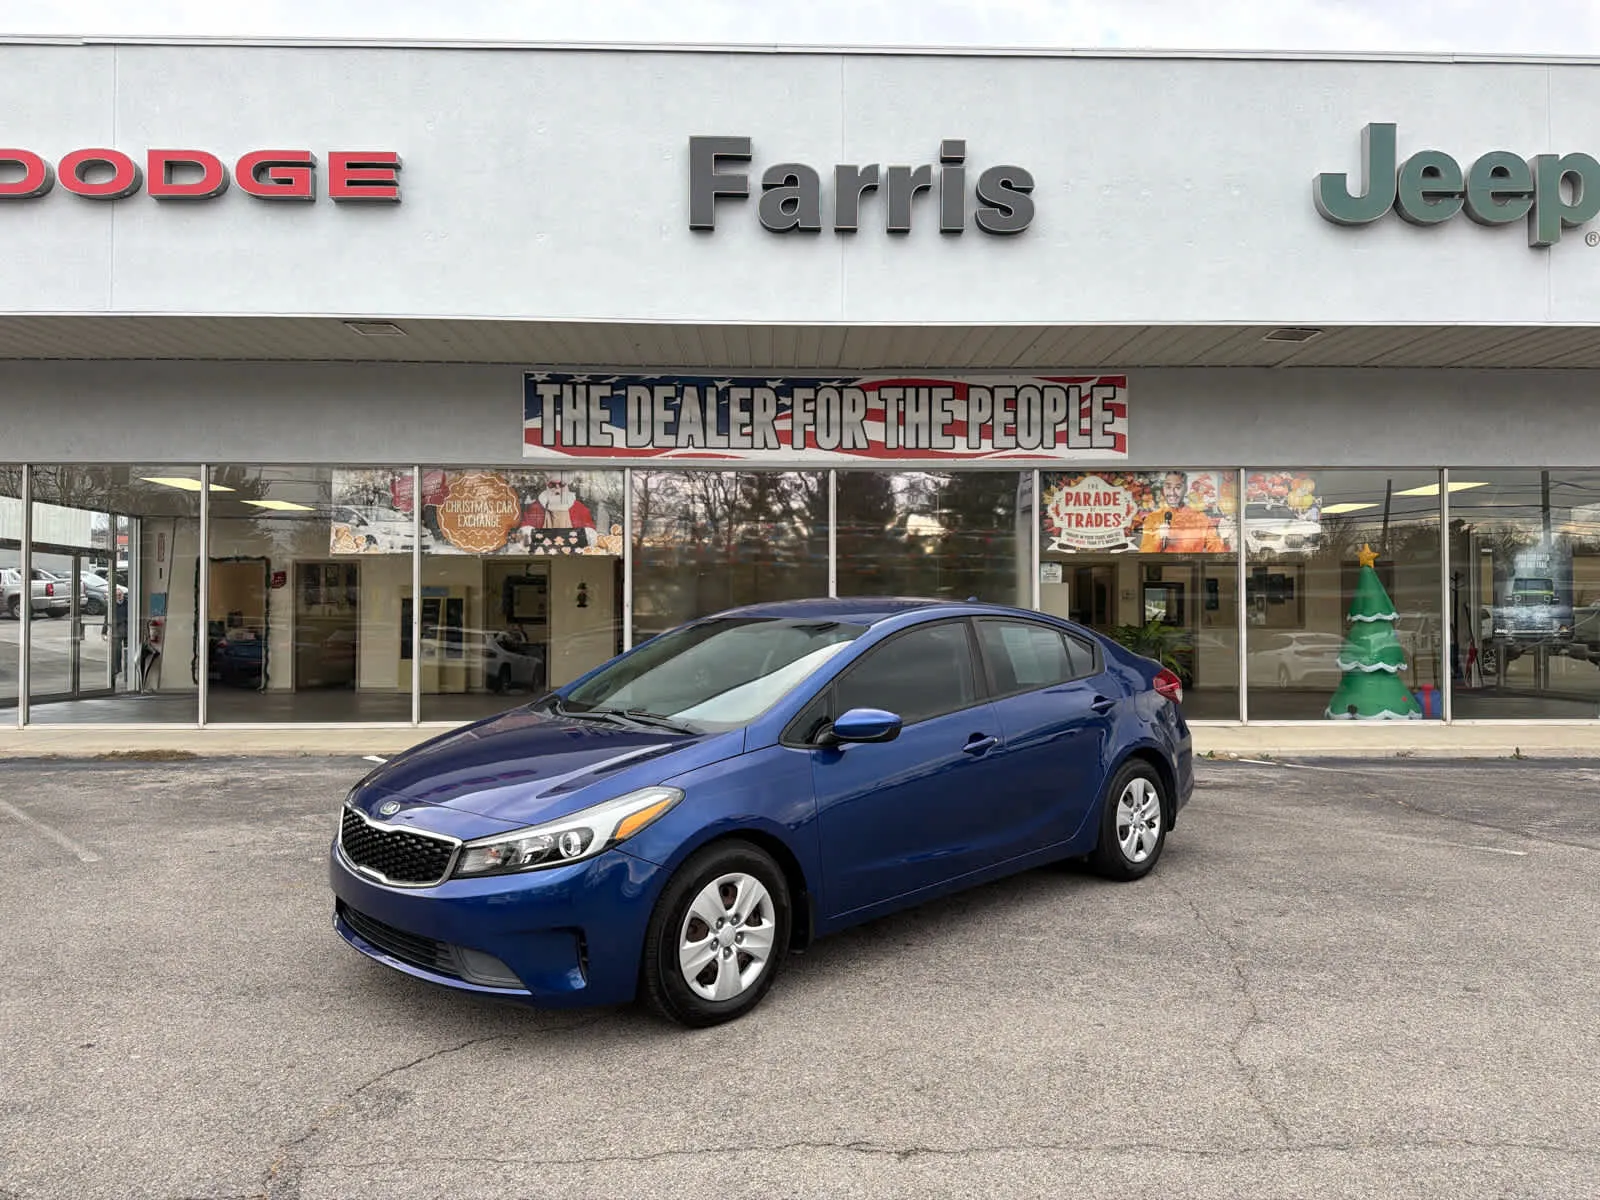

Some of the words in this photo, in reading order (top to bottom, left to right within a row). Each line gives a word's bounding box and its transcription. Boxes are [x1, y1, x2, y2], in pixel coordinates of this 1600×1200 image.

[0, 148, 401, 203] DODGE
[688, 135, 1036, 235] Farris
[1312, 122, 1600, 248] Jeep
[535, 382, 615, 449] THE
[624, 383, 781, 450] DEALER
[791, 385, 869, 451] FOR
[879, 384, 956, 450] THE
[966, 384, 1117, 451] PEOPLE
[445, 499, 494, 514] CHRISTMAS
[496, 500, 513, 513] CAR
[1064, 491, 1122, 507] PARADE
[457, 514, 502, 528] EXCHANGE
[1064, 512, 1122, 528] TRADES
